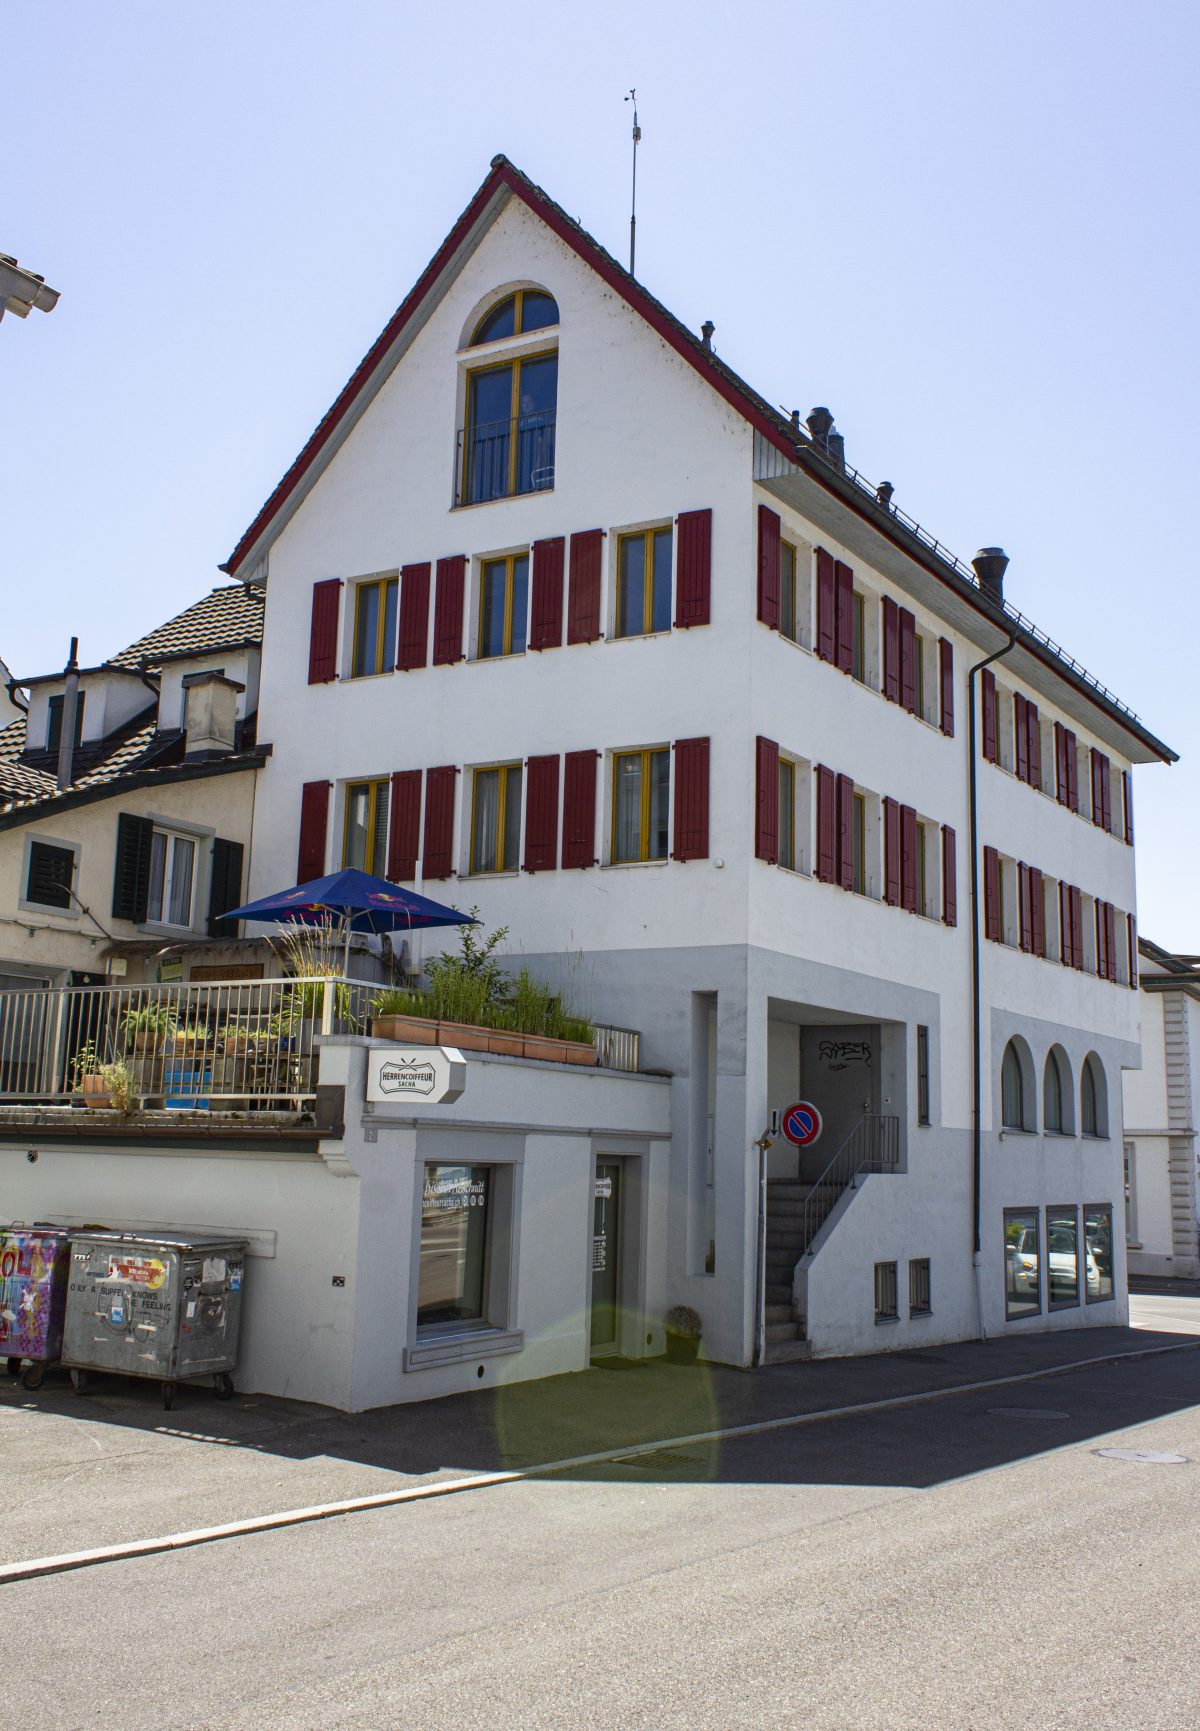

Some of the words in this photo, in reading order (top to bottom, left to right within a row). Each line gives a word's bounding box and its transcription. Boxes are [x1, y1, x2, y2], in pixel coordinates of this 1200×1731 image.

[382, 1071, 433, 1083] HERRENCOIFFEUR
[398, 1080, 416, 1088] SACHA
[133, 1290, 158, 1300] KNOWS
[142, 1301, 172, 1312] FEELING
